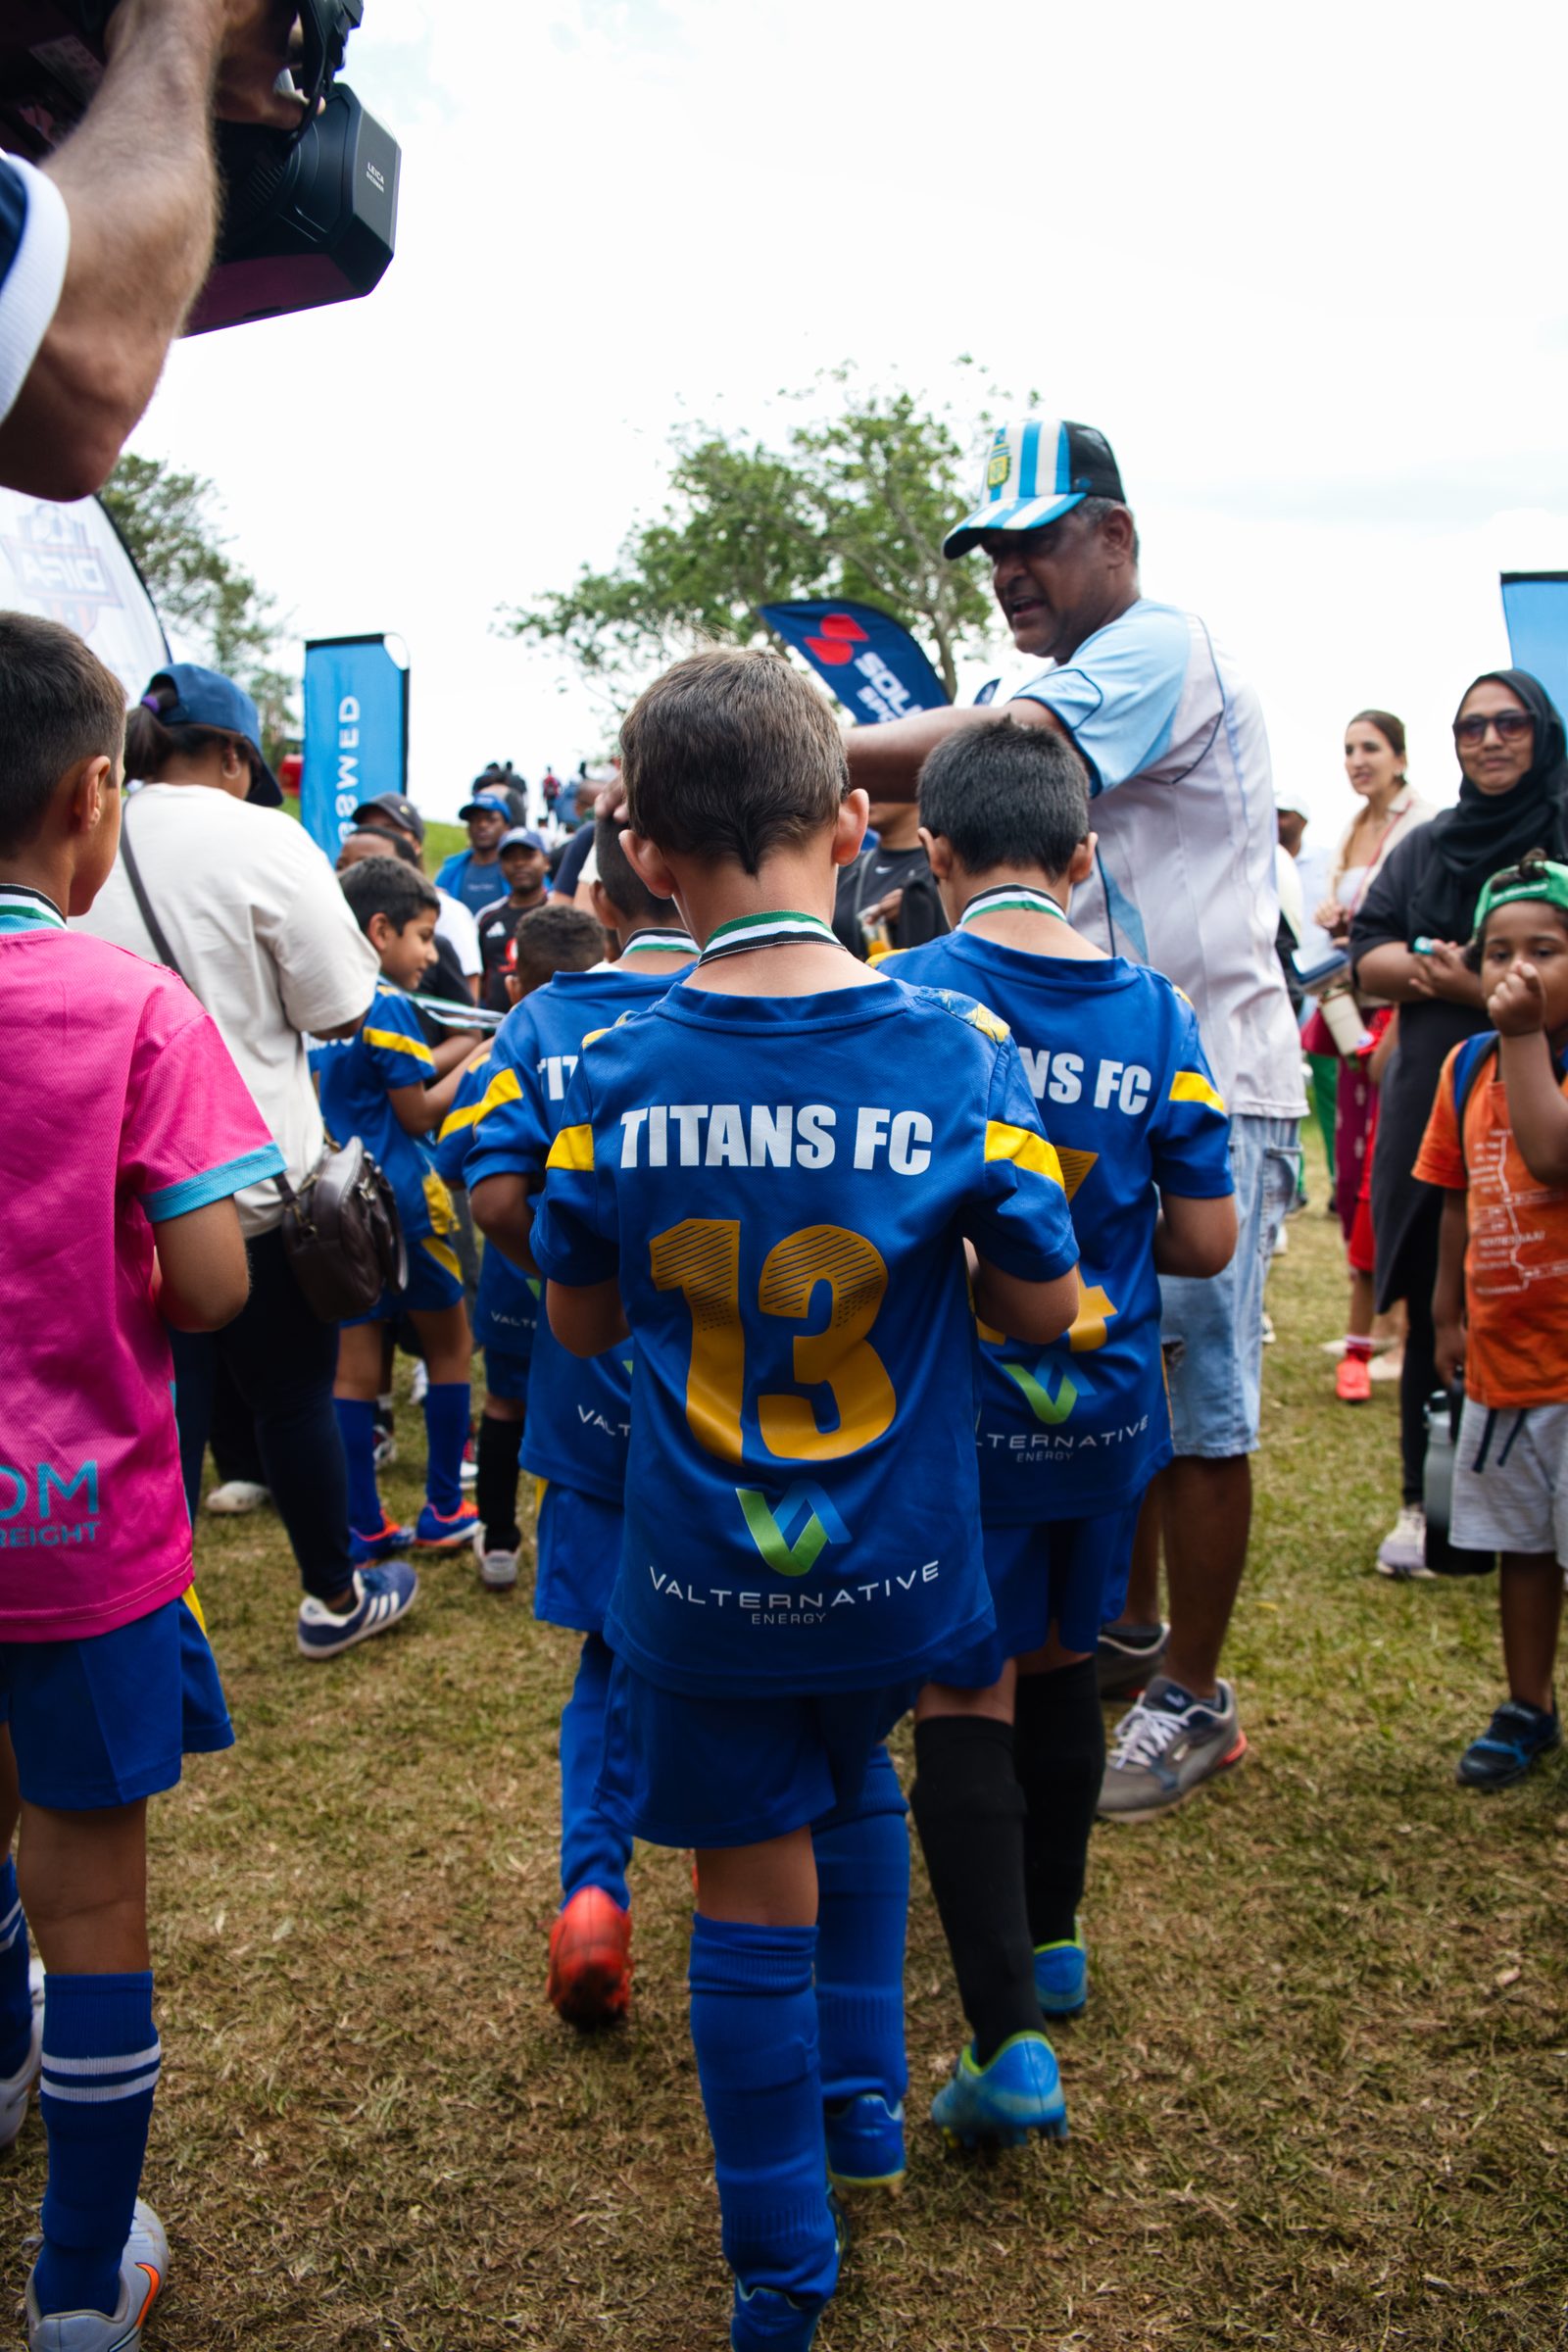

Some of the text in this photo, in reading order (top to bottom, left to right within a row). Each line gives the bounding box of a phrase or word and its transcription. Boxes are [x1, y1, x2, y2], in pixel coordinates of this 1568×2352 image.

[1094, 1058, 1152, 1115] FC
[619, 1103, 933, 1176] TITANS FC
[649, 1218, 897, 1466] 13
[975, 1413, 1150, 1450] TERNATIVE
[1015, 1450, 1075, 1463] ENERGY
[649, 1559, 940, 1610] VALTERNATIVE
[751, 1611, 827, 1626] ENERGY
